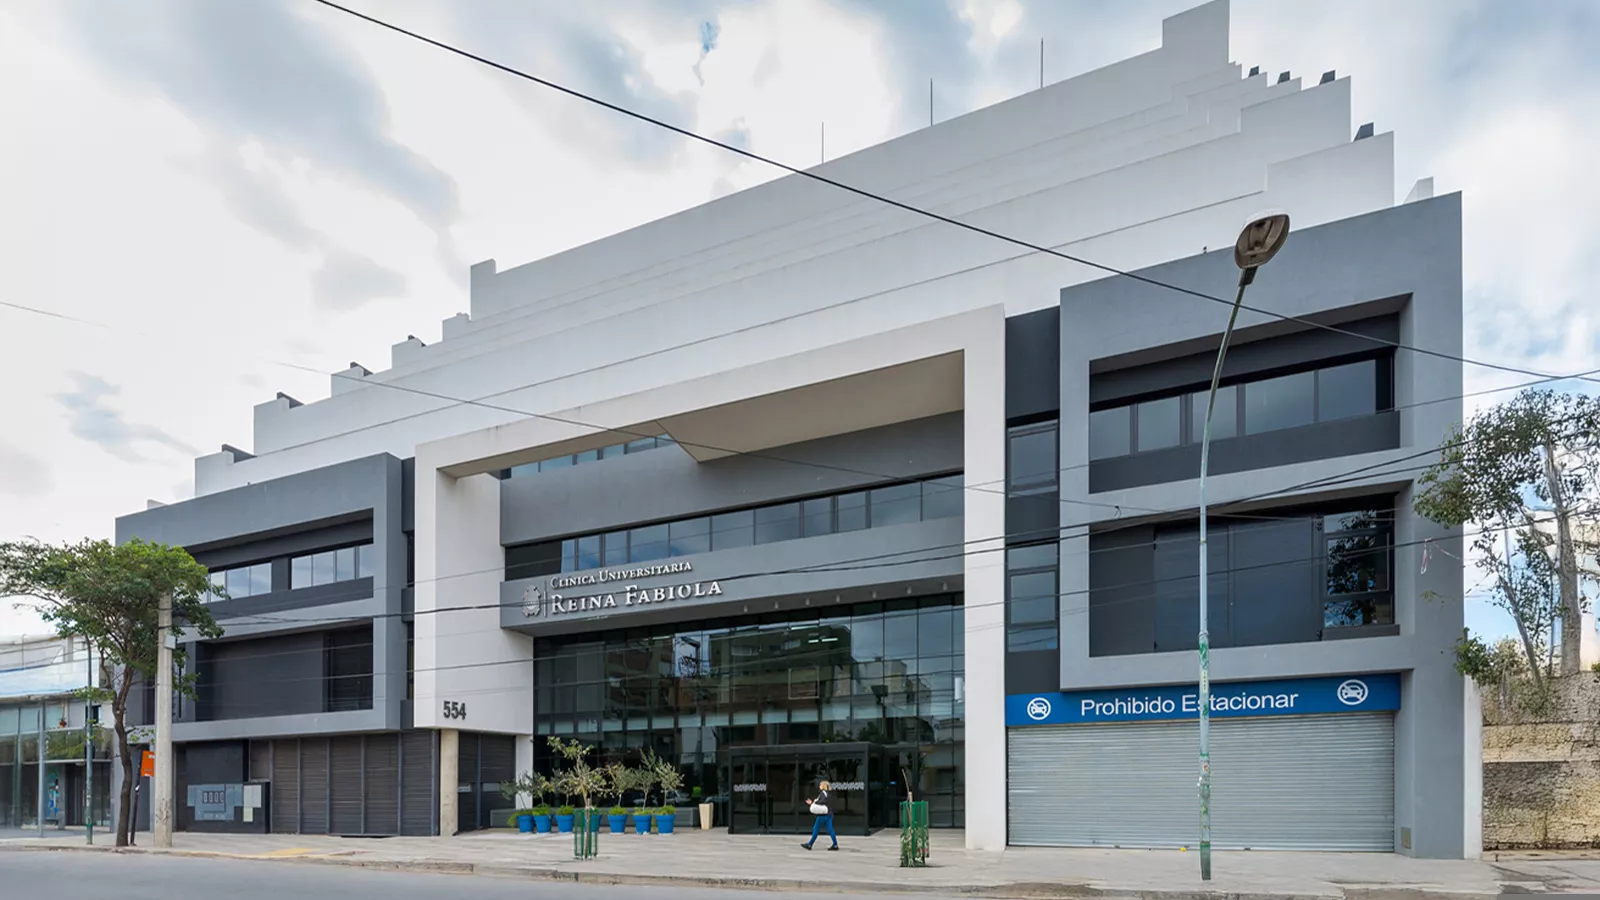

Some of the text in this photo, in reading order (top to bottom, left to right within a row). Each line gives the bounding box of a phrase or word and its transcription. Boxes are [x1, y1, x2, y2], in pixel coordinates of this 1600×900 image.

[599, 561, 692, 582] UNIVERSITARIA
[551, 581, 722, 615] REINA FABIOLA
[443, 700, 467, 720] 554
[1081, 692, 1299, 716] Prohibido Etacionar
